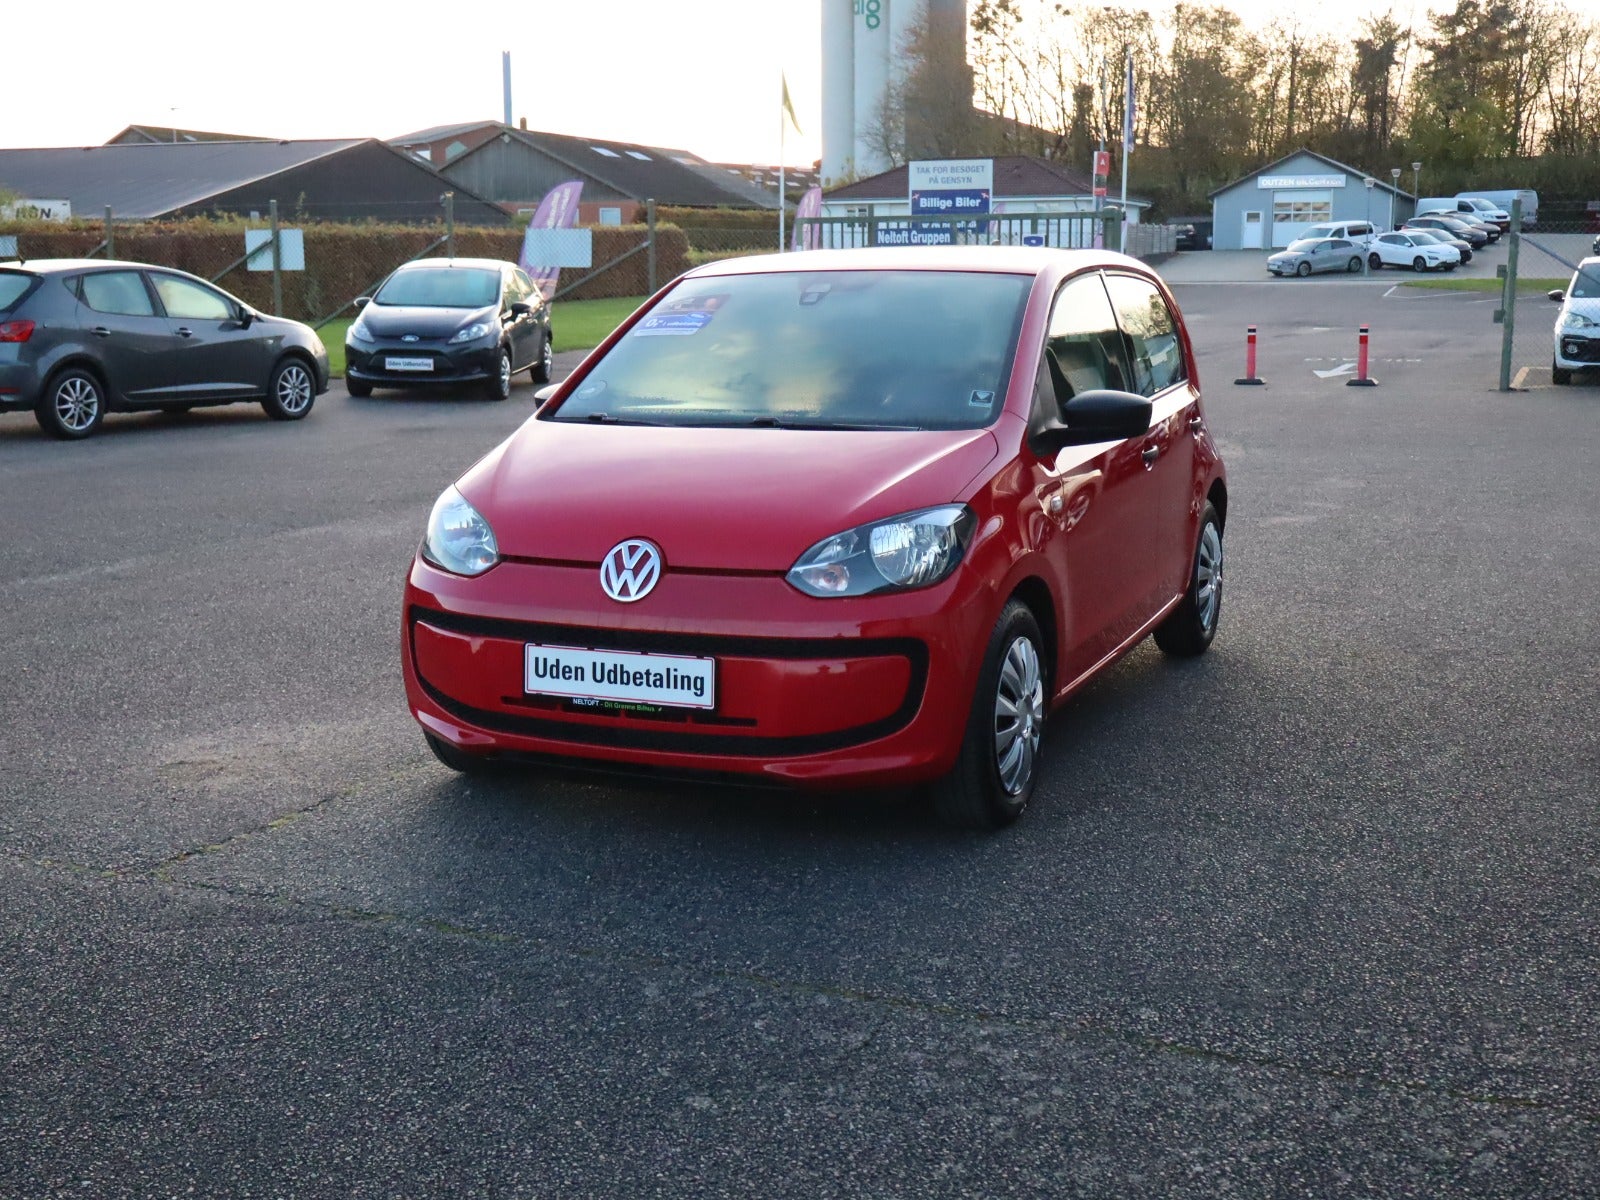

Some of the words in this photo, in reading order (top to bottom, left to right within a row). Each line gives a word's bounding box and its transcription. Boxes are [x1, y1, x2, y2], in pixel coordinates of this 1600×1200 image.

[916, 166, 931, 174] TAK
[933, 166, 948, 174] FOR
[920, 197, 953, 210] Billige
[955, 197, 981, 207] Biler
[877, 230, 909, 244] Neltoft
[910, 230, 951, 246] Gruppen
[533, 656, 585, 682] Uden
[592, 660, 705, 697] Udbetaling
[572, 697, 600, 707] NELTOFT
